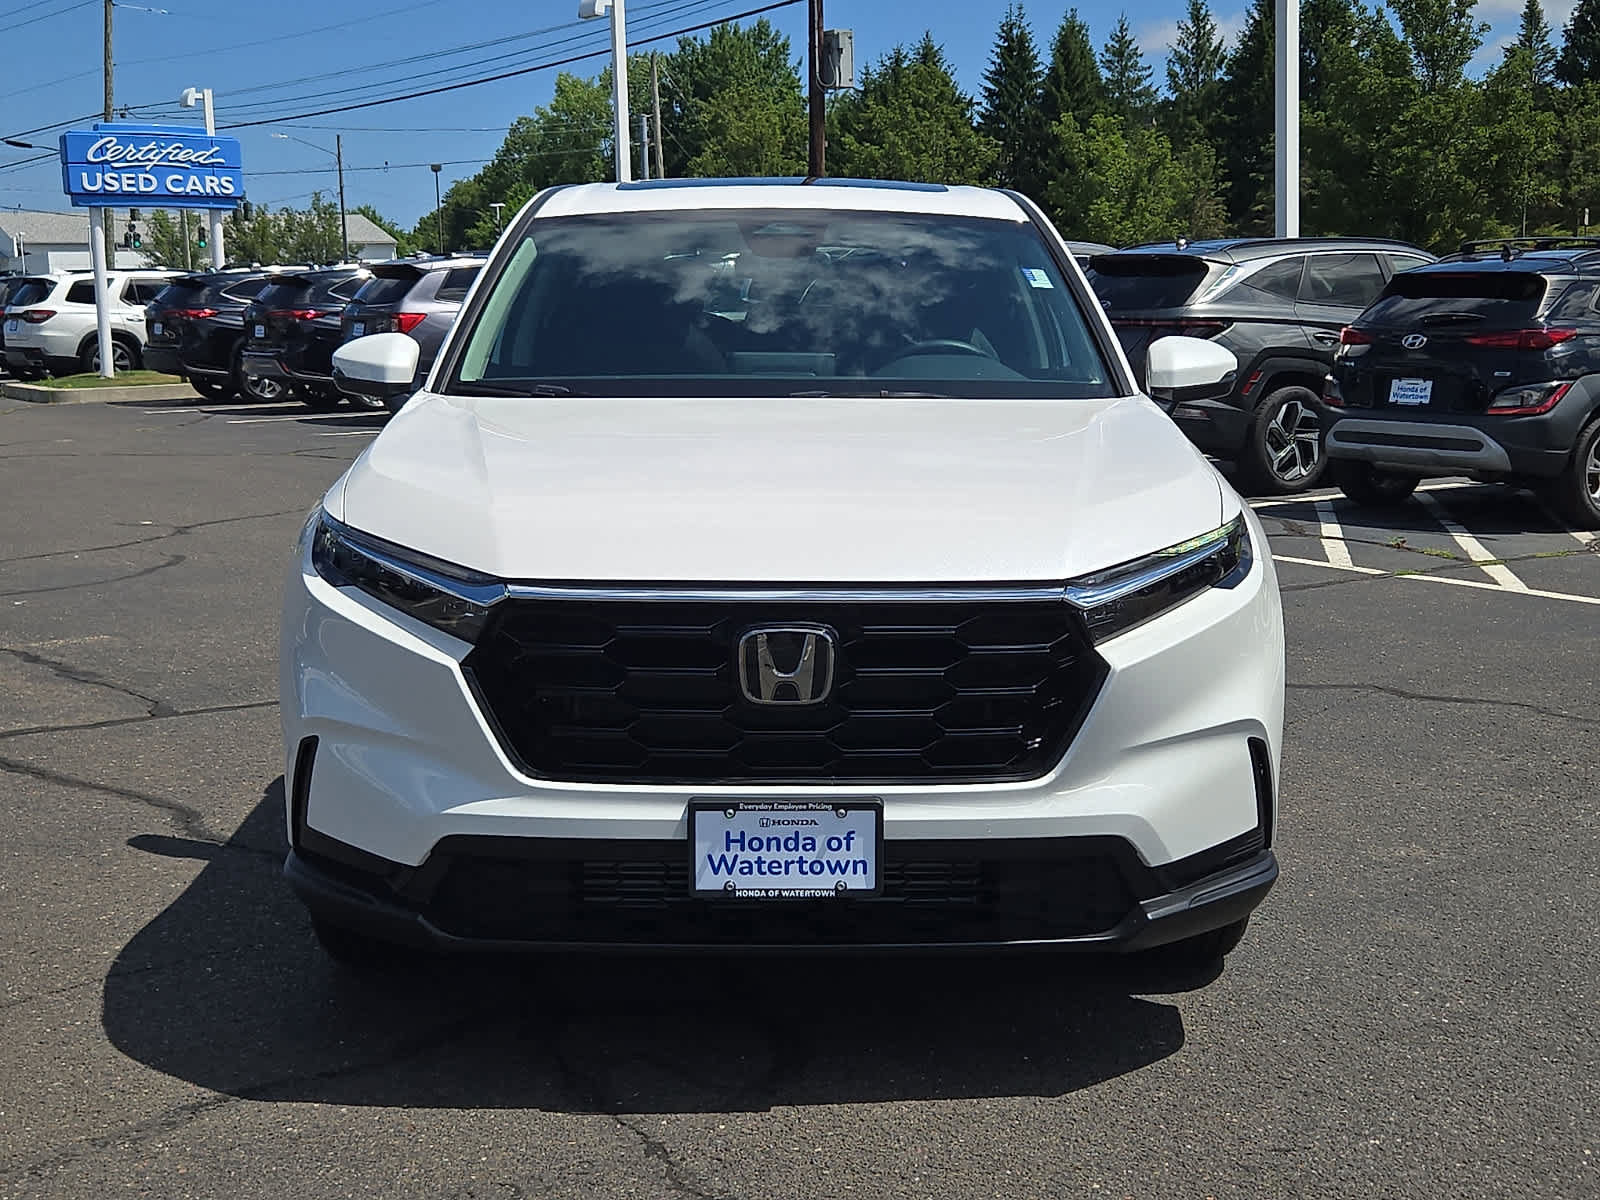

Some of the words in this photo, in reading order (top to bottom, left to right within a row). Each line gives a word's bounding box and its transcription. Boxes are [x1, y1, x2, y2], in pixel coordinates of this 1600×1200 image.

[87, 137, 225, 171] Certified
[81, 172, 158, 192] USED
[166, 174, 235, 194] CARS
[739, 803, 772, 811] Everyday
[773, 803, 807, 811] Employee
[808, 803, 833, 811] Pricing
[725, 830, 816, 852] Honda
[826, 830, 856, 852] of
[707, 853, 868, 876] Watertown
[735, 889, 767, 898] HONDA
[767, 889, 780, 898] OF
[782, 889, 836, 898] WATERTOWN
